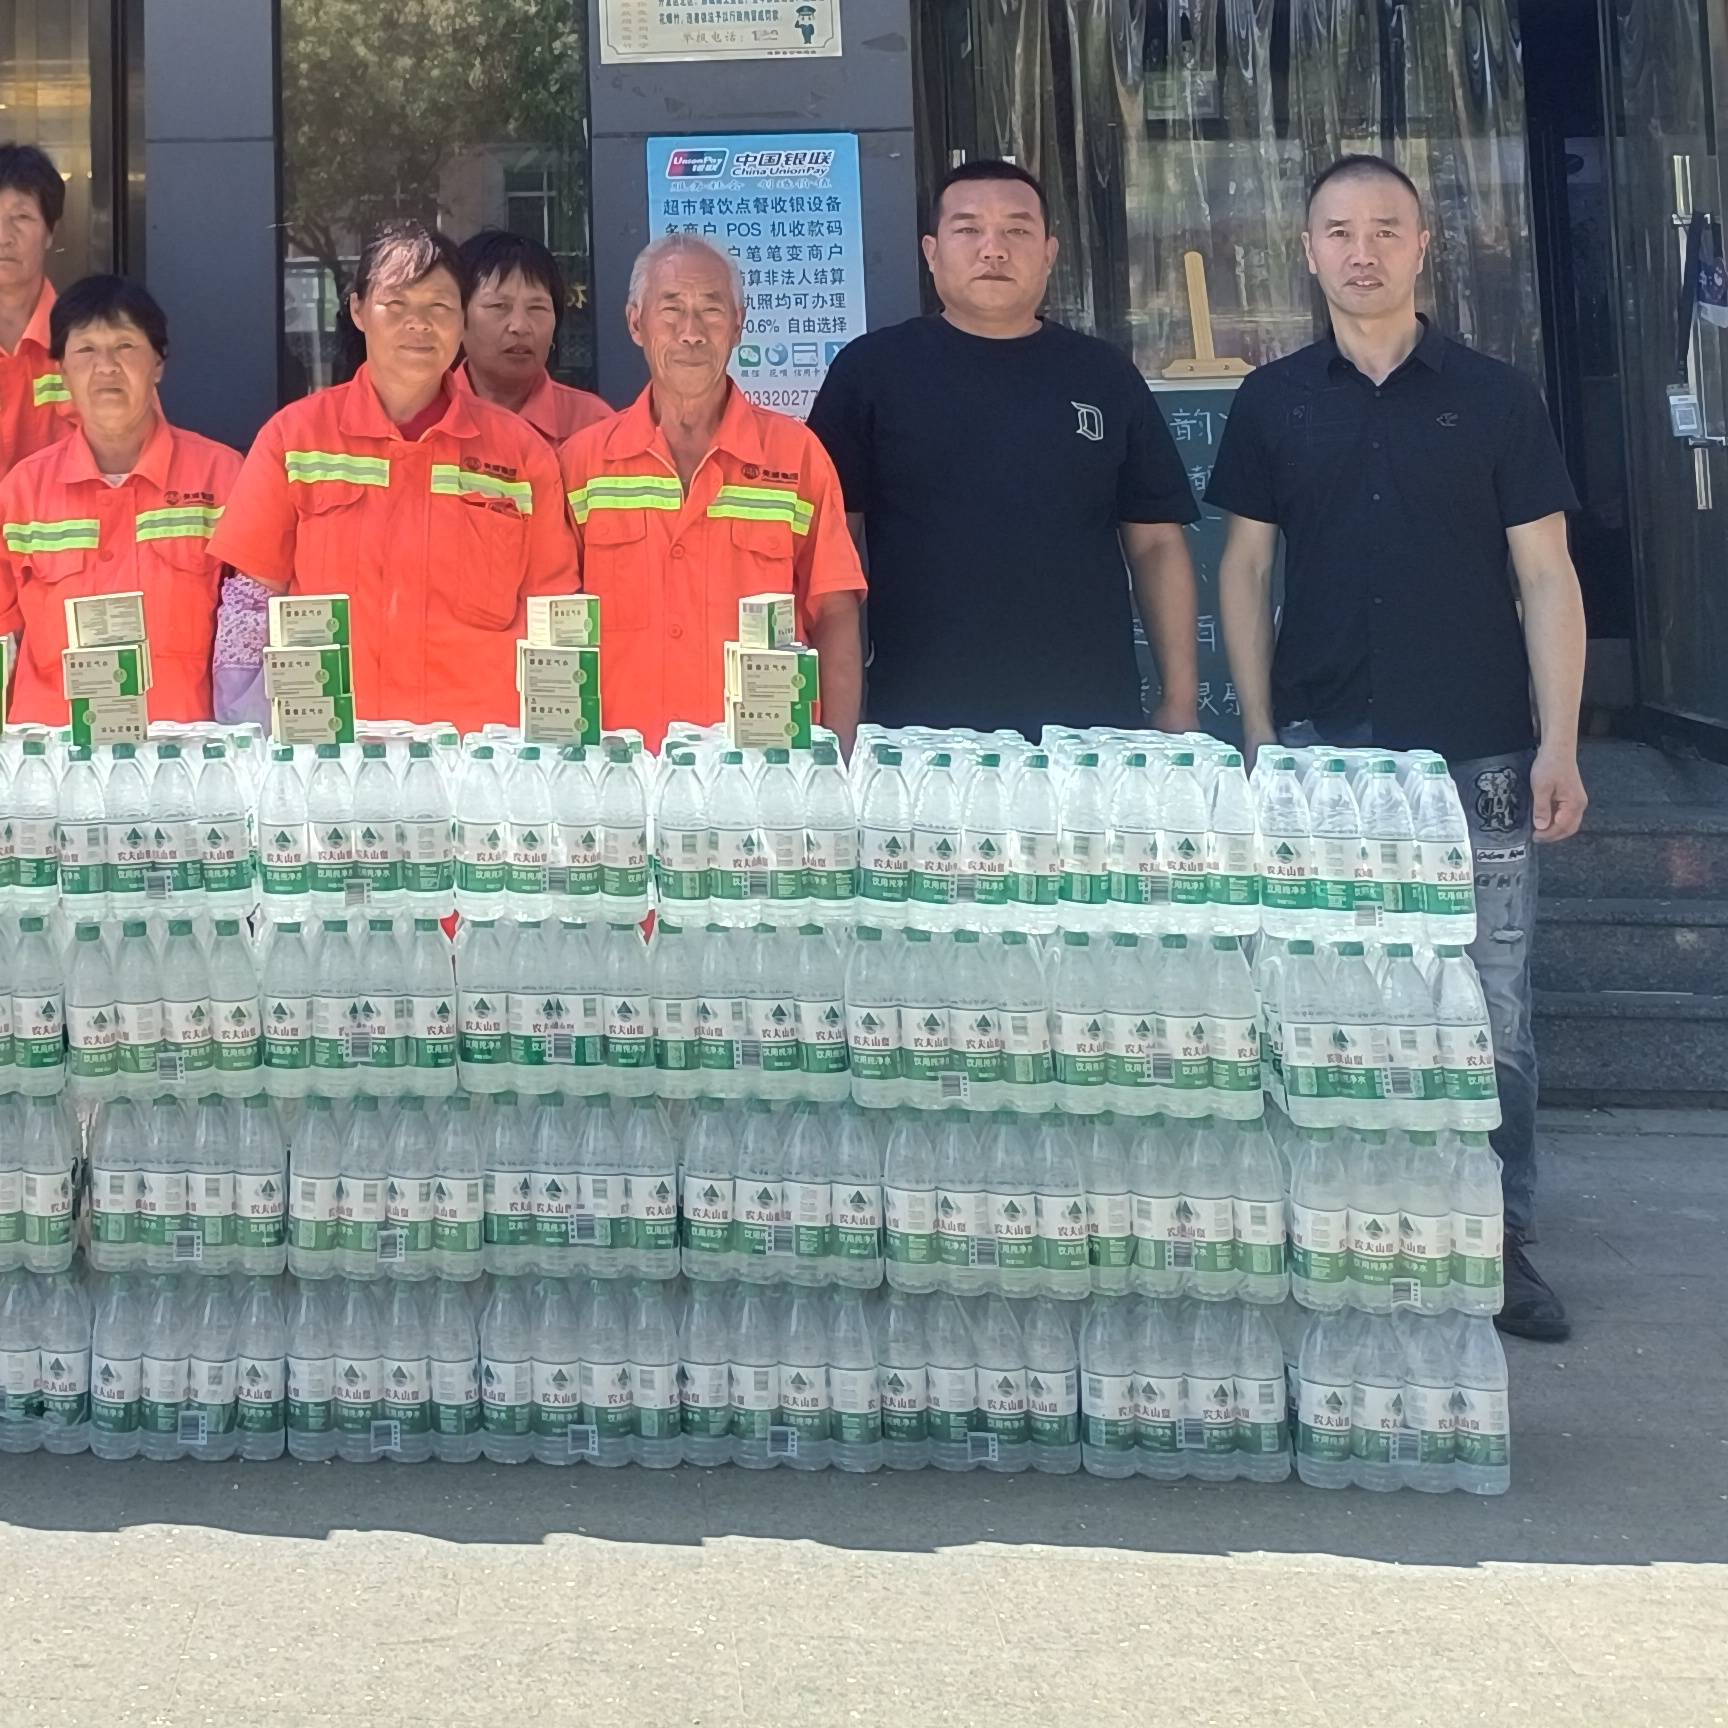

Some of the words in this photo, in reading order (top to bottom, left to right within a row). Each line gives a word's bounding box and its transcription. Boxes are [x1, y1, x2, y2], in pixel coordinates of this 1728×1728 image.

[735, 151, 833, 167] 中国银联
[732, 167, 767, 176] China
[770, 166, 828, 177] UnionPay
[663, 196, 842, 216] 超市餐饮点餐收银设备
[727, 222, 762, 237] POS
[771, 220, 843, 237] 机收款码
[788, 316, 848, 334] 自由选择
